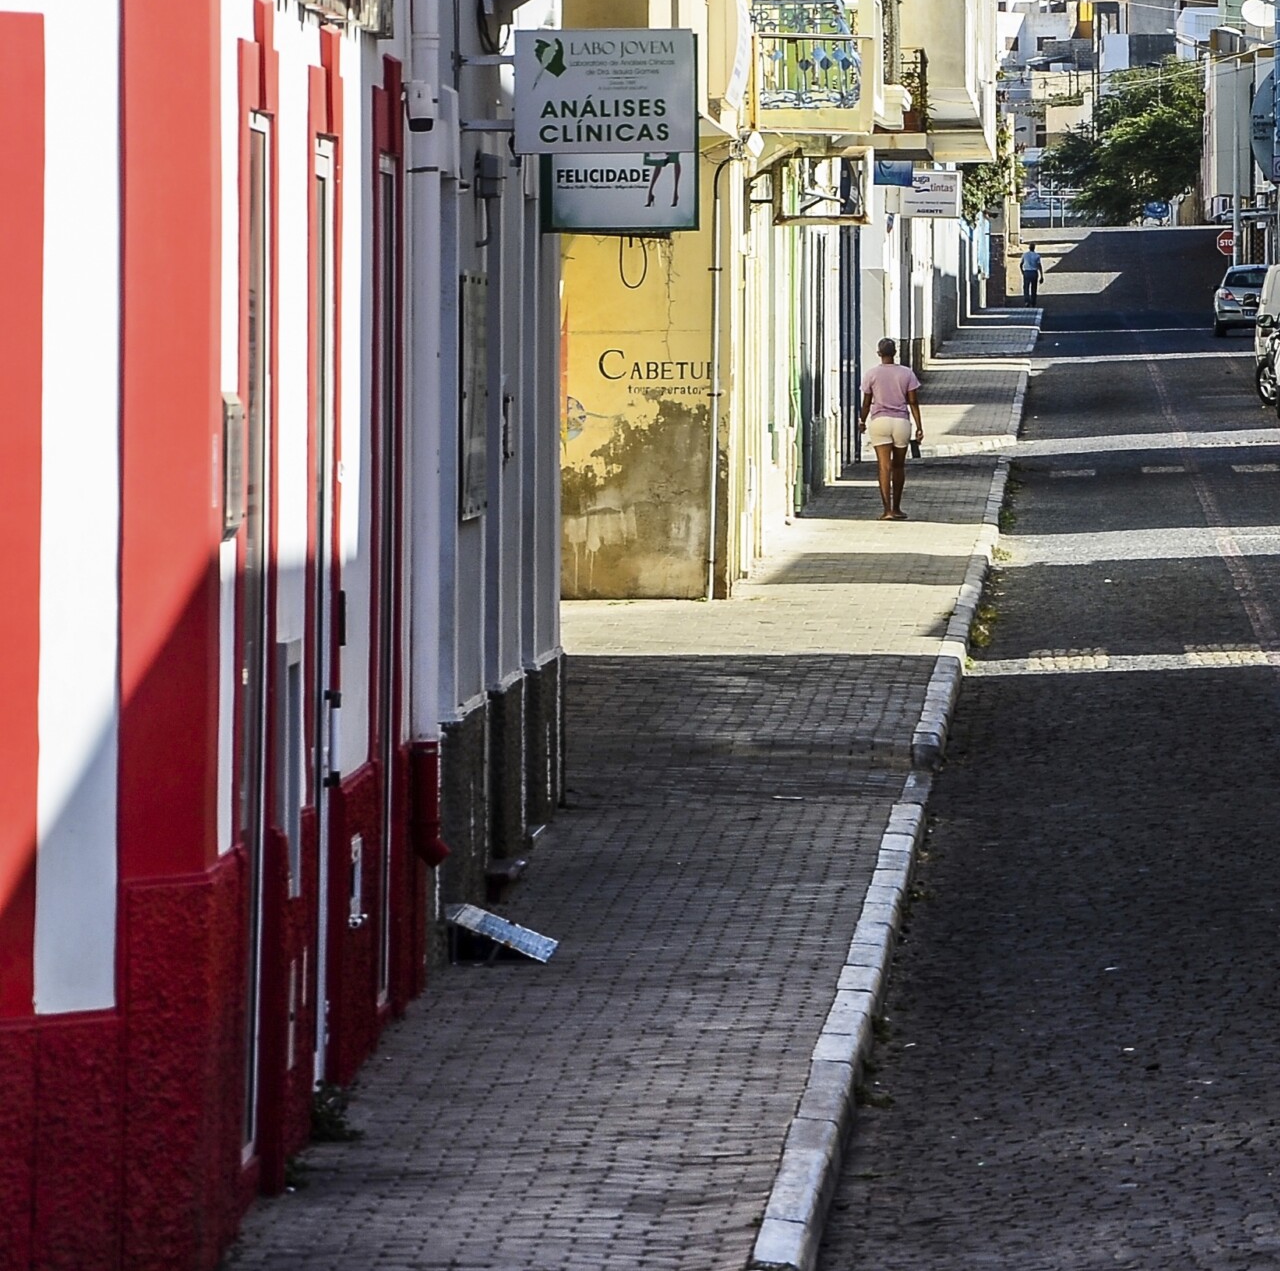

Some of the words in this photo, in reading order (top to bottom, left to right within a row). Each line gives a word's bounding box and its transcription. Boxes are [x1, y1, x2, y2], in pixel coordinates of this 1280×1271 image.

[570, 40, 615, 56] LABO
[620, 40, 675, 58] JOVEM
[540, 95, 666, 119] ANÁLISES
[539, 119, 670, 143] CLÍNICAS
[556, 168, 650, 183] FELICIDADE
[930, 183, 954, 193] tintas
[1219, 239, 1234, 247] STO
